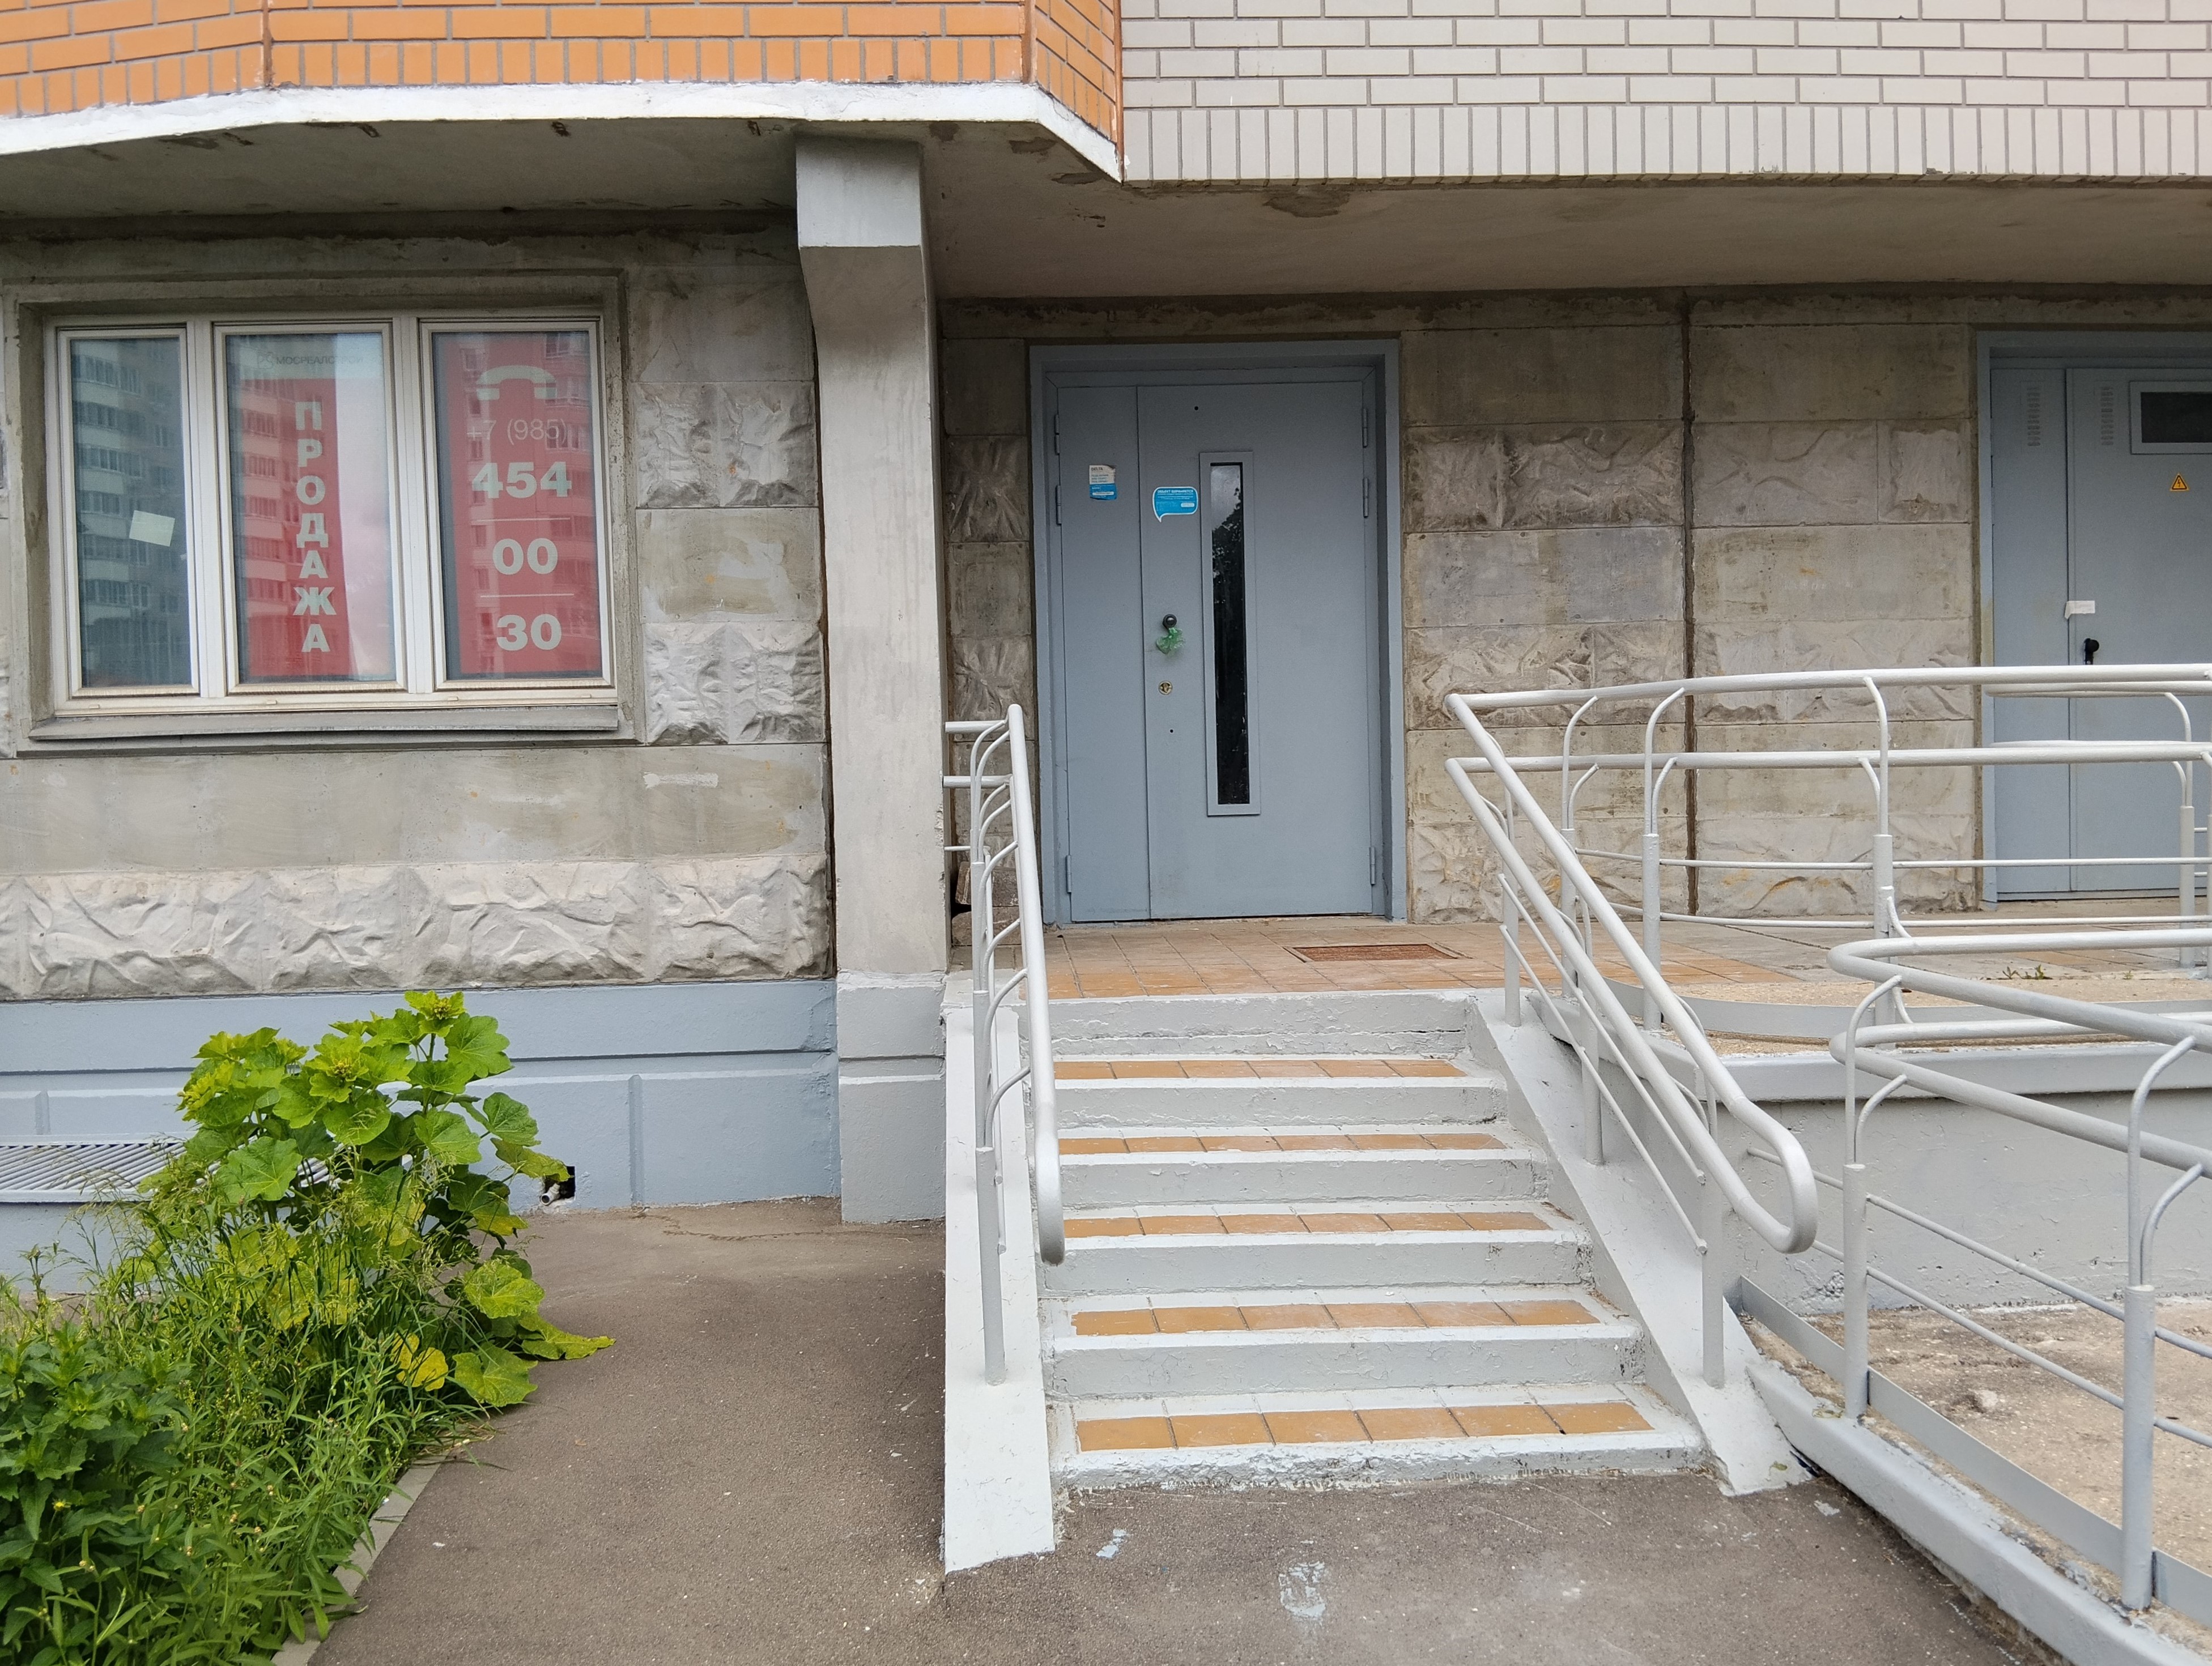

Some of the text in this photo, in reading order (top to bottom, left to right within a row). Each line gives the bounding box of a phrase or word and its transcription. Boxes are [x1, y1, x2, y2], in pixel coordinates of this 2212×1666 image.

[276, 355, 364, 365] МОСРЕАЛСРОЙ
[467, 418, 567, 446] +7 (985)
[471, 461, 572, 499] 454
[293, 401, 337, 653] ПРОДАЖА
[492, 538, 558, 575] 00
[496, 613, 561, 651] 30
